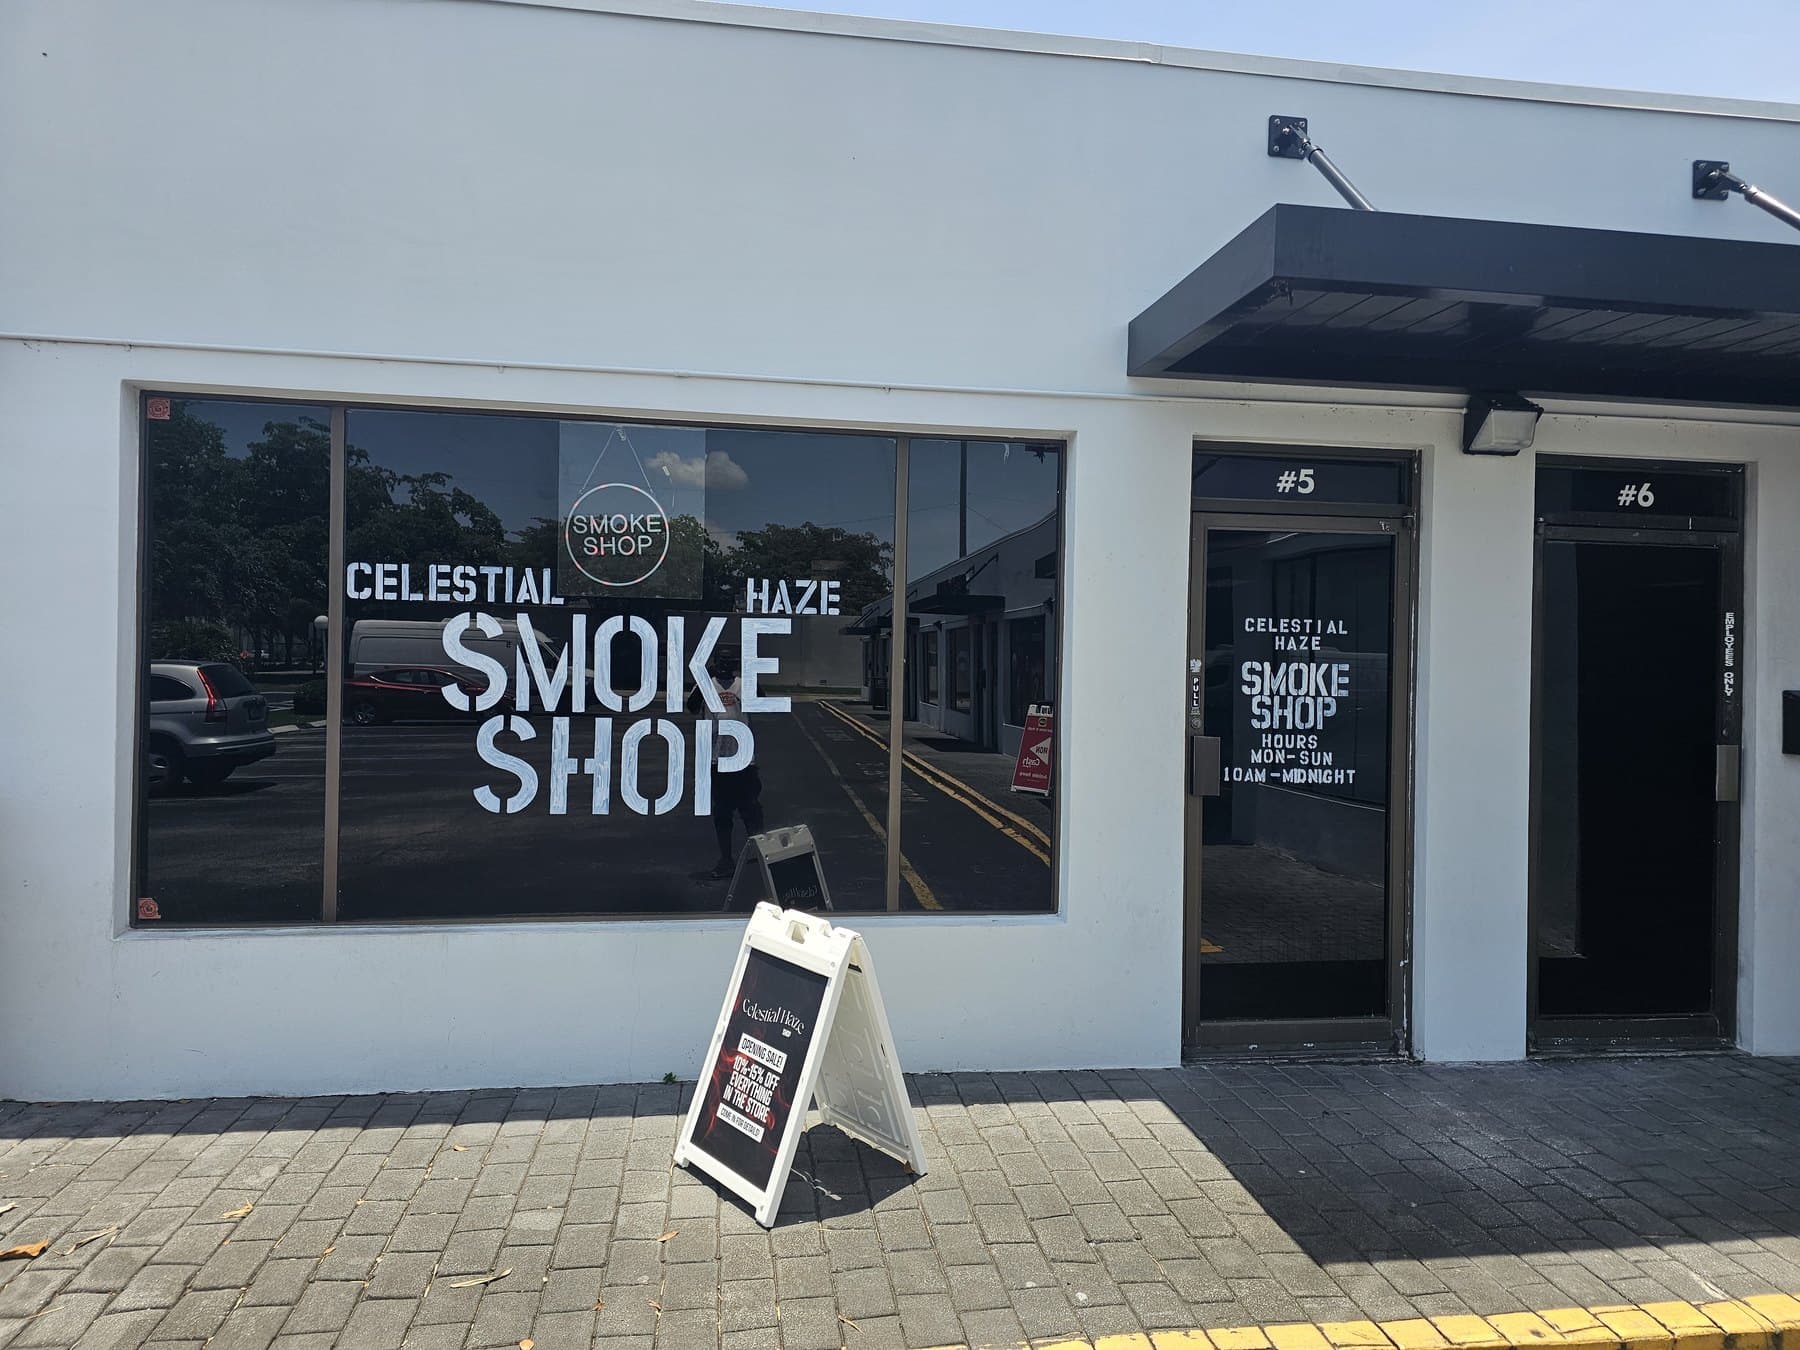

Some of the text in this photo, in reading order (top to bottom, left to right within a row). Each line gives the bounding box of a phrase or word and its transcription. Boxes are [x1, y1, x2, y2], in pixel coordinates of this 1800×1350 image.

[1276, 468, 1316, 495] #5
[1617, 482, 1655, 508] #6
[572, 512, 663, 534] SMOKE
[583, 535, 652, 556] SHOP
[346, 561, 841, 616] CELESTIAL HAZE
[1244, 617, 1348, 635] CELESTIAL
[1275, 635, 1321, 651] HAZE
[1724, 612, 1735, 697] EMPLOYEES ONLY
[441, 611, 792, 714] SMOKE
[1241, 661, 1350, 697] SMOKE
[1250, 695, 1337, 730] SHOP
[1261, 734, 1318, 749] HOURS
[472, 714, 755, 817] SHOP
[742, 999, 805, 1035] Celestial Haze
[741, 1039, 784, 1067] OPENING SALE!
[729, 1071, 773, 1106] EVERYTHING
[764, 1071, 781, 1090] OFF
[722, 1085, 771, 1123] IN THE STORE
